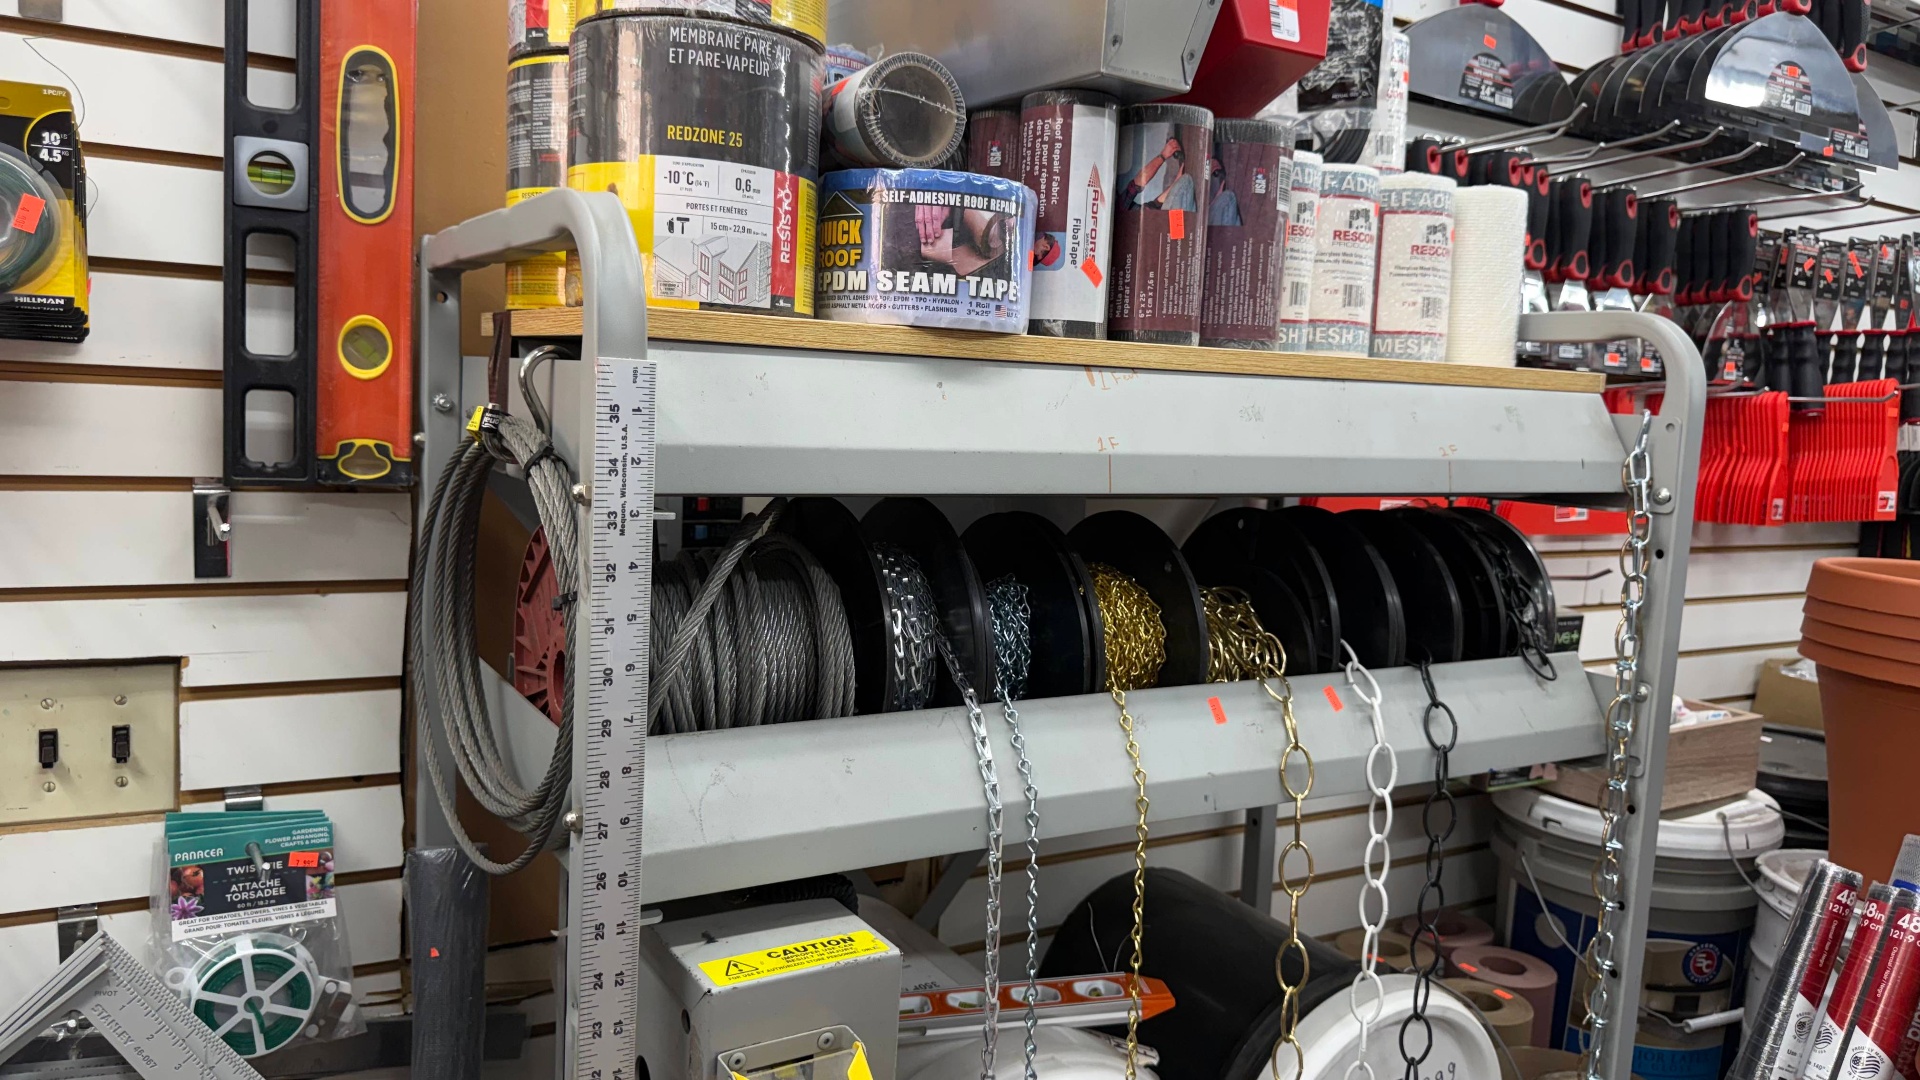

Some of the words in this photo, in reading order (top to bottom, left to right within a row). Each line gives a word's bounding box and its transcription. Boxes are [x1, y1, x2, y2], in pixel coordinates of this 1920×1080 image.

[670, 26, 740, 50] MEMBRANE
[744, 36, 791, 62] PARE-AIR
[669, 48, 684, 63] ET
[689, 50, 769, 77] PARE-VAPEUR
[667, 125, 725, 145] REDZONE
[729, 132, 743, 148] 25
[1044, 118, 1052, 142] Toile
[1054, 118, 1064, 140] Roof
[42, 132, 61, 146] 10
[40, 148, 62, 162] 4.5
[1034, 138, 1042, 176] toitures
[1042, 144, 1050, 166] pour
[1052, 142, 1062, 174] Repair
[735, 178, 751, 193] 0,6
[1050, 176, 1060, 205] Fabric
[686, 202, 709, 212] PORTES
[719, 205, 748, 216] FENÊTRES
[882, 190, 962, 206] SELF-ADHESIVE
[963, 194, 988, 210] ROOF
[990, 198, 1016, 215] REPAIR
[711, 222, 717, 230] 15
[734, 225, 745, 234] 22,9
[818, 270, 867, 291] EPDM
[877, 270, 957, 295] SEAM
[966, 275, 1019, 302] TAPE
[14, 296, 65, 305] HILLMAN
[1146, 309, 1152, 317] 15
[1374, 338, 1432, 354] MESH
[609, 404, 620, 423] 35
[1108, 437, 1119, 449] F
[1439, 447, 1448, 457] 2
[1449, 444, 1458, 453] F
[608, 458, 619, 477] 34
[631, 457, 641, 466] 2
[620, 452, 628, 498] Wisconsin,
[607, 511, 617, 530] 33
[619, 501, 627, 536] Mequon,
[630, 510, 639, 518] 3
[606, 563, 616, 582] 32
[628, 562, 638, 571] 4
[605, 617, 615, 635] 31
[603, 668, 613, 686] 30
[625, 664, 635, 672] 6
[601, 719, 612, 737] 29
[624, 715, 633, 723] 7
[600, 770, 610, 789] 28
[265, 836, 291, 844] FLOWER
[292, 832, 329, 840] ARRANGING,
[292, 826, 329, 835] GARDENING,
[598, 822, 608, 840] 27
[280, 840, 304, 848] CRAFTS
[227, 866, 256, 875] TWIS
[618, 872, 628, 887] 10
[230, 879, 281, 892] ATTACHE
[596, 872, 607, 890] 26
[226, 887, 286, 902] TORSADEE
[211, 912, 242, 921] TOMATOES,
[244, 909, 271, 917] FLOWERS,
[294, 900, 328, 909] VEGETABLES
[1828, 902, 1850, 917] 121,9
[184, 926, 204, 934] GRAND
[224, 920, 250, 928] TOMATES,
[275, 913, 295, 921] VIGNES
[595, 922, 605, 941] 25
[616, 921, 626, 935] 11
[1897, 913, 1920, 933] 48
[1889, 928, 1915, 943] 121,9
[766, 936, 856, 959] CAUTION
[1888, 947, 1899, 966] Charcoal
[767, 962, 805, 973] AUTHORIZED
[806, 957, 825, 966] STORE
[594, 972, 603, 990] 24
[614, 970, 625, 987] 12
[1877, 983, 1886, 998] Negro
[91, 1003, 134, 1047] STANLEY
[592, 1021, 602, 1039] 23
[613, 1019, 623, 1036] 13
[146, 1034, 154, 1042] 2
[133, 1046, 158, 1069] 46-067
[1875, 1052, 1885, 1064] MADE
